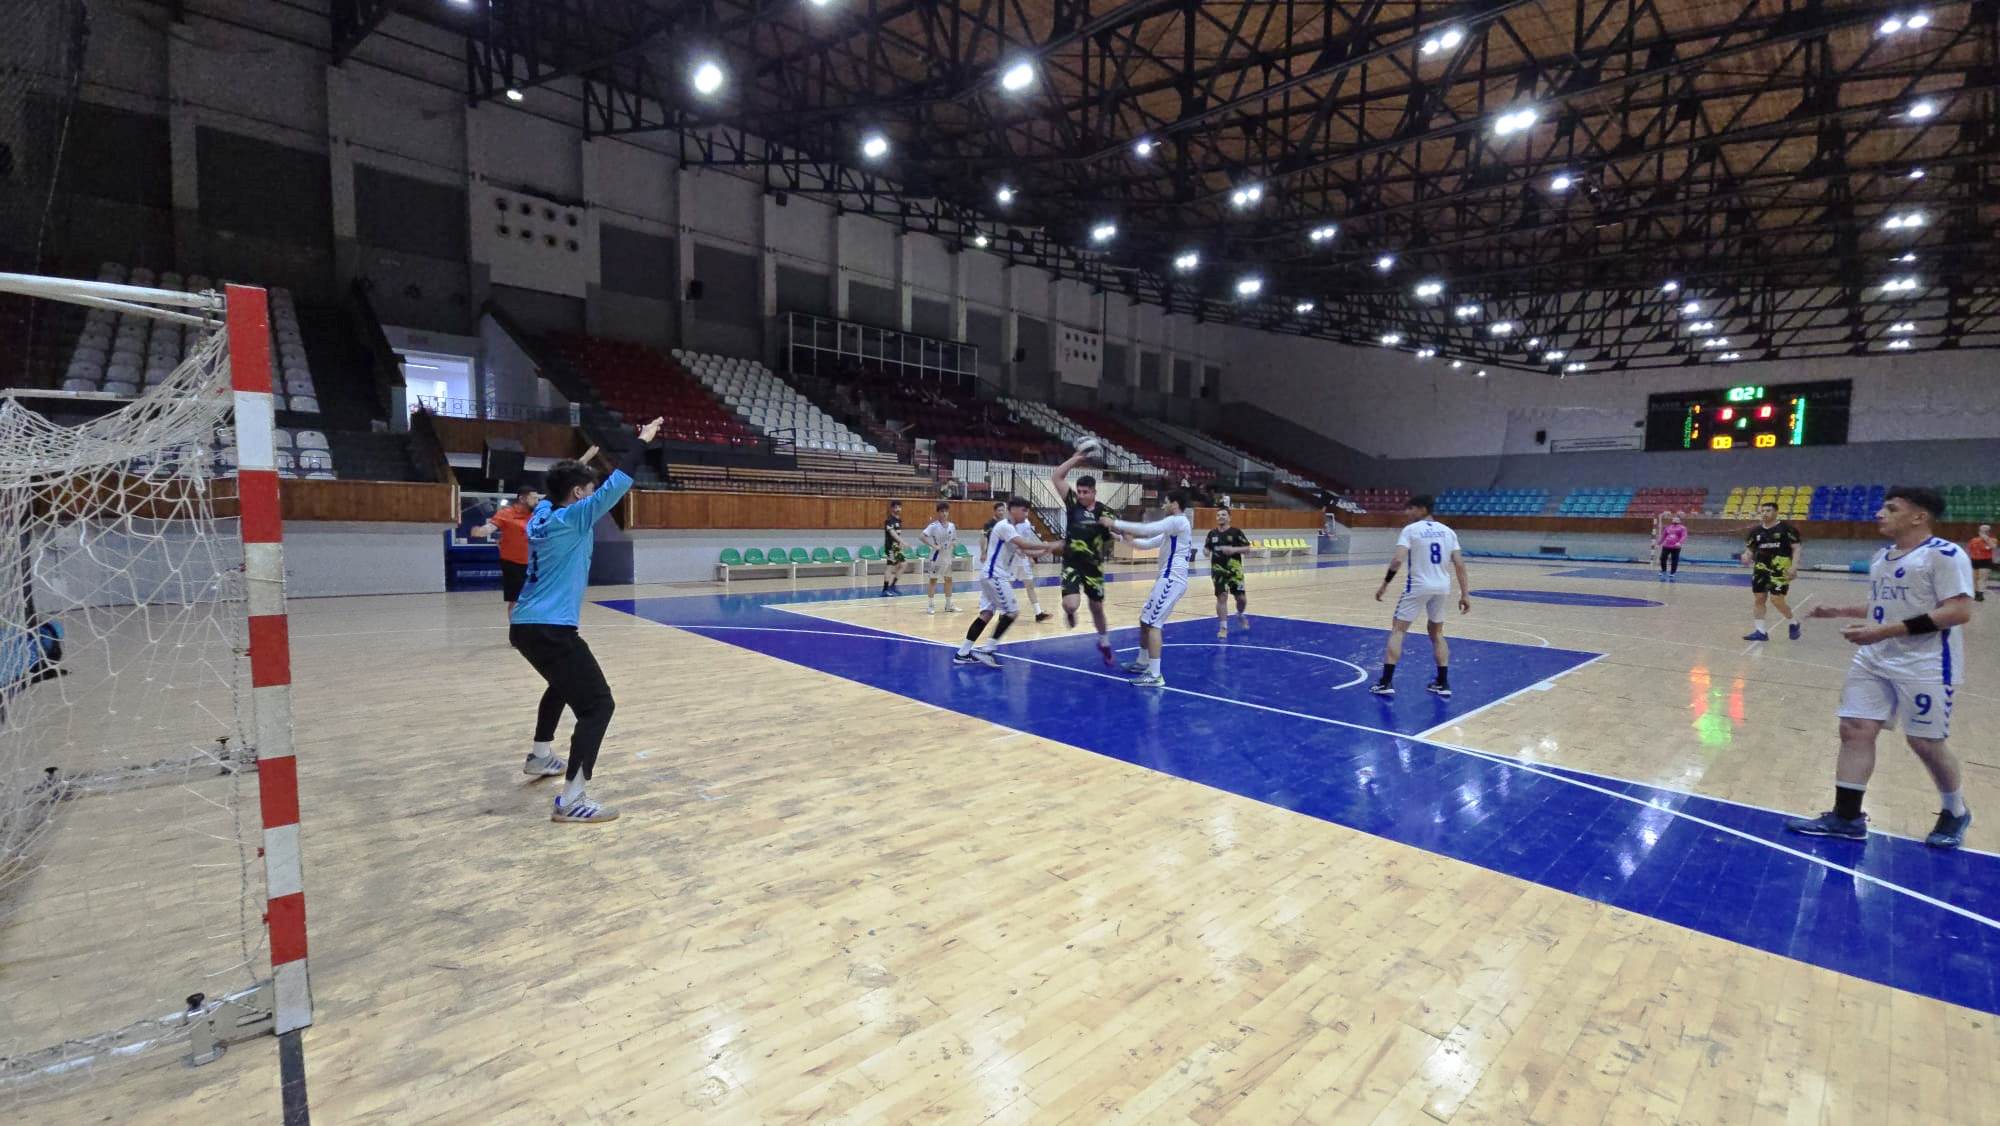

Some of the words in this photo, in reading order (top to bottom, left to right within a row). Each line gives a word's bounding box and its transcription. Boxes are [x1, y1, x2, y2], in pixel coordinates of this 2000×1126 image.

[1756, 434, 1776, 448] 09
[1430, 542, 1441, 564] 8
[1873, 606, 1884, 624] 9
[1915, 693, 1932, 715] 9
